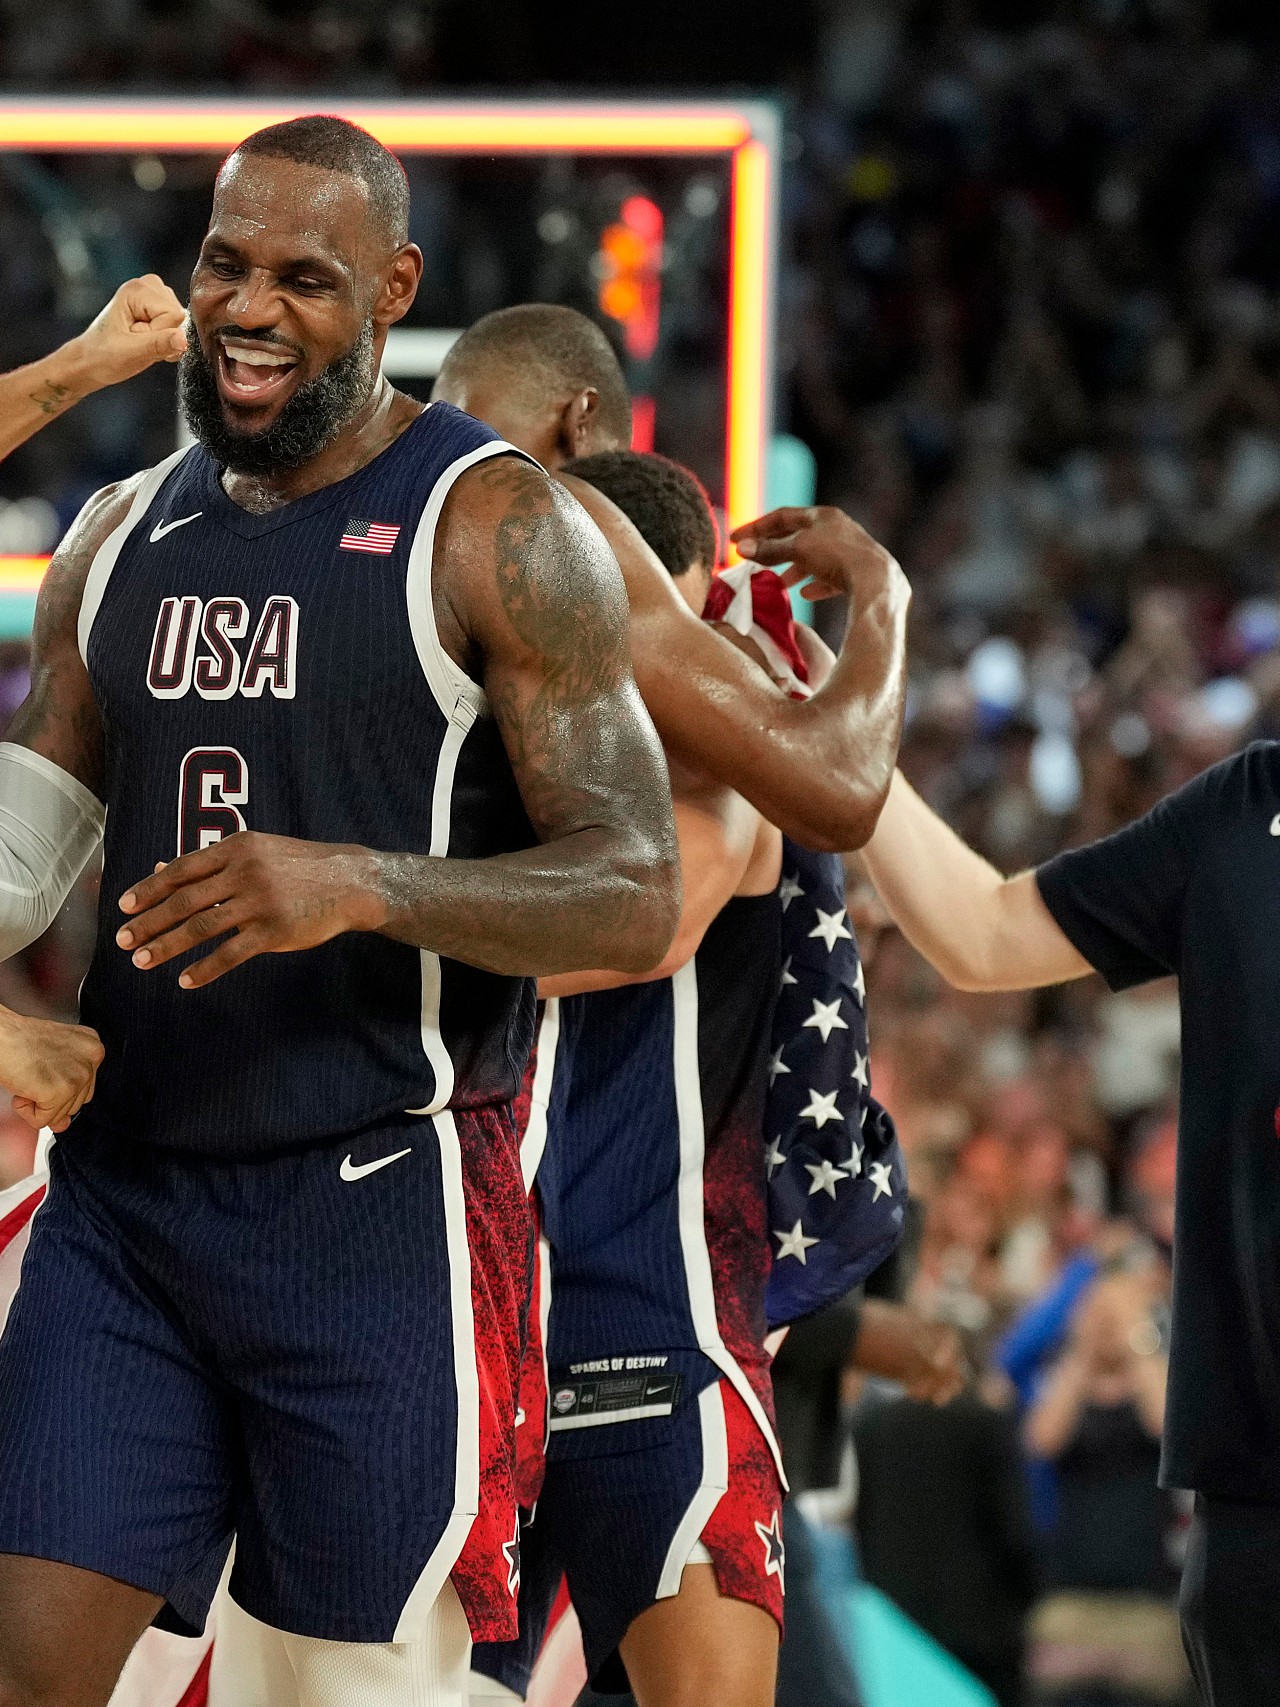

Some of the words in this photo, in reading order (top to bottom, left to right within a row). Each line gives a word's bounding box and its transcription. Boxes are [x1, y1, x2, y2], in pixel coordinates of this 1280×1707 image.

[146, 595, 300, 700] USA
[177, 746, 248, 857] 6
[570, 1360, 610, 1374] SPARKS
[611, 1358, 625, 1371] OF
[626, 1356, 668, 1370] DESTINY
